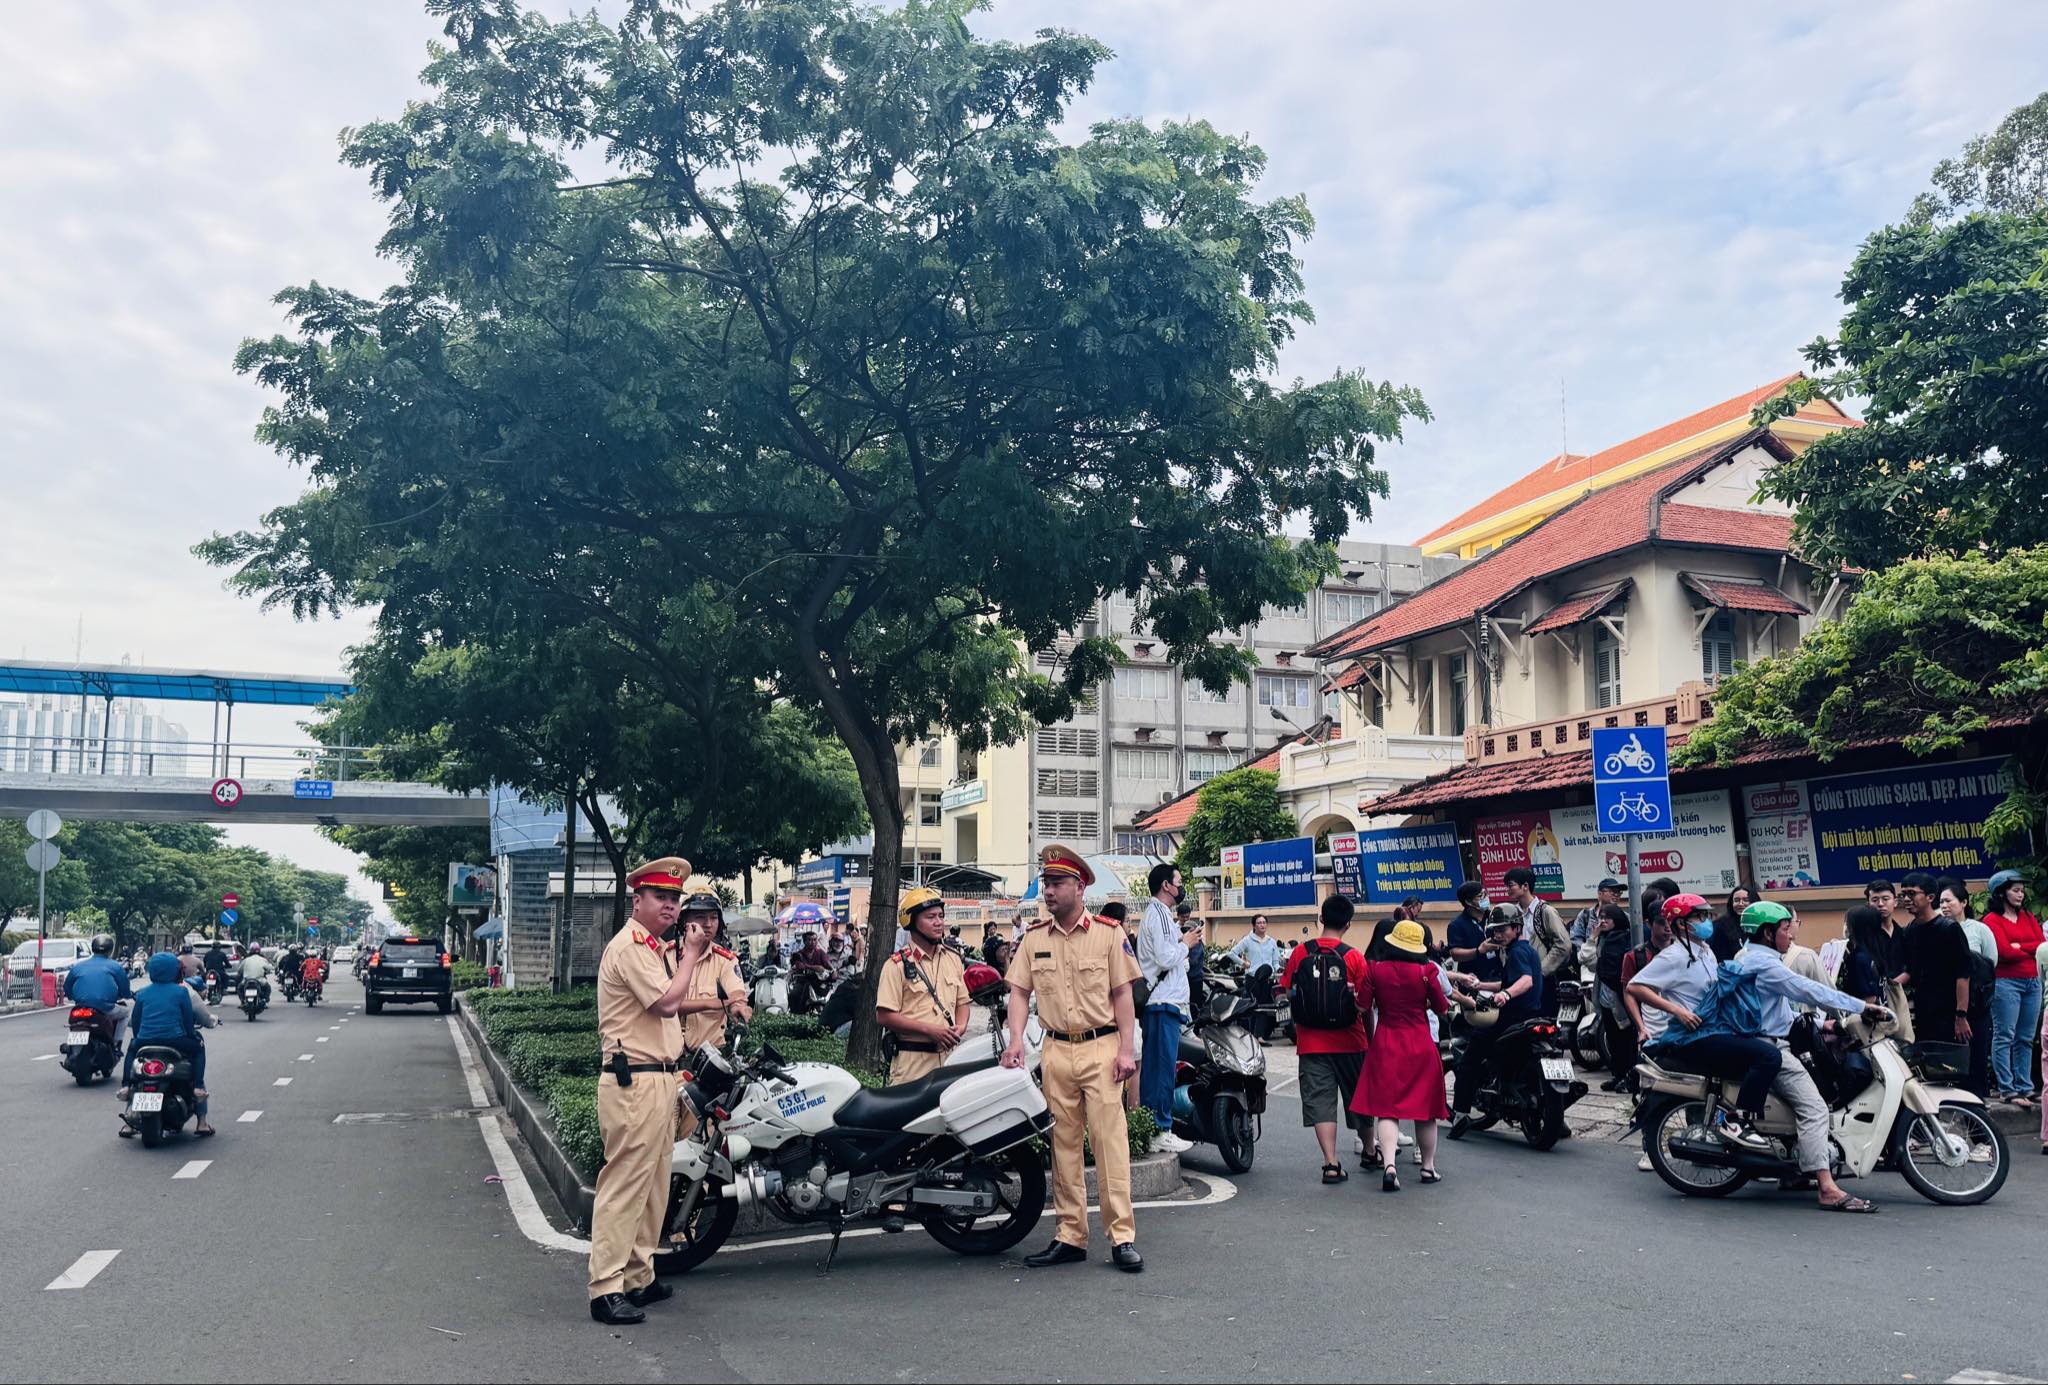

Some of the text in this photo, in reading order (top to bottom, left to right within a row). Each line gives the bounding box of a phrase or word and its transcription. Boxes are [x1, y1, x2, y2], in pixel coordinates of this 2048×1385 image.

[1845, 783, 1893, 809] TRƯỜNG
[1893, 781, 1931, 807] SẠCH,
[1931, 777, 1958, 804] ĐẸP,
[1959, 775, 1978, 797] AN
[1752, 795, 1777, 809] giáo
[1511, 819, 1522, 827] Anh
[1580, 822, 1593, 833] Khi
[1680, 812, 1700, 824] kiến
[1709, 824, 1726, 834] học
[1787, 820, 1809, 839] EF
[1479, 831, 1524, 848] DOL IELTS
[1751, 825, 1785, 838] DU HỌC
[1822, 828, 1839, 852] Đội
[1856, 825, 1875, 847] bảo
[1875, 822, 1901, 845] hiểm
[1901, 822, 1919, 843] khi
[1919, 820, 1944, 844] ngồi
[1944, 820, 1969, 840] trên
[1428, 835, 1438, 848] AN
[1481, 847, 1526, 865] ĐÌNH LỰC
[1653, 857, 1665, 867] 111
[1857, 846, 1982, 872] xe gắn máy, xe đạp điện.
[1409, 861, 1424, 873] giao
[1424, 858, 1445, 872] thông
[1543, 866, 1562, 875] IELTS
[1416, 877, 1435, 893] hạnh
[1435, 876, 1453, 890] phúc
[777, 1089, 808, 1110] C.S.G.T
[782, 1095, 826, 1119] TRAFFIC POLICE
